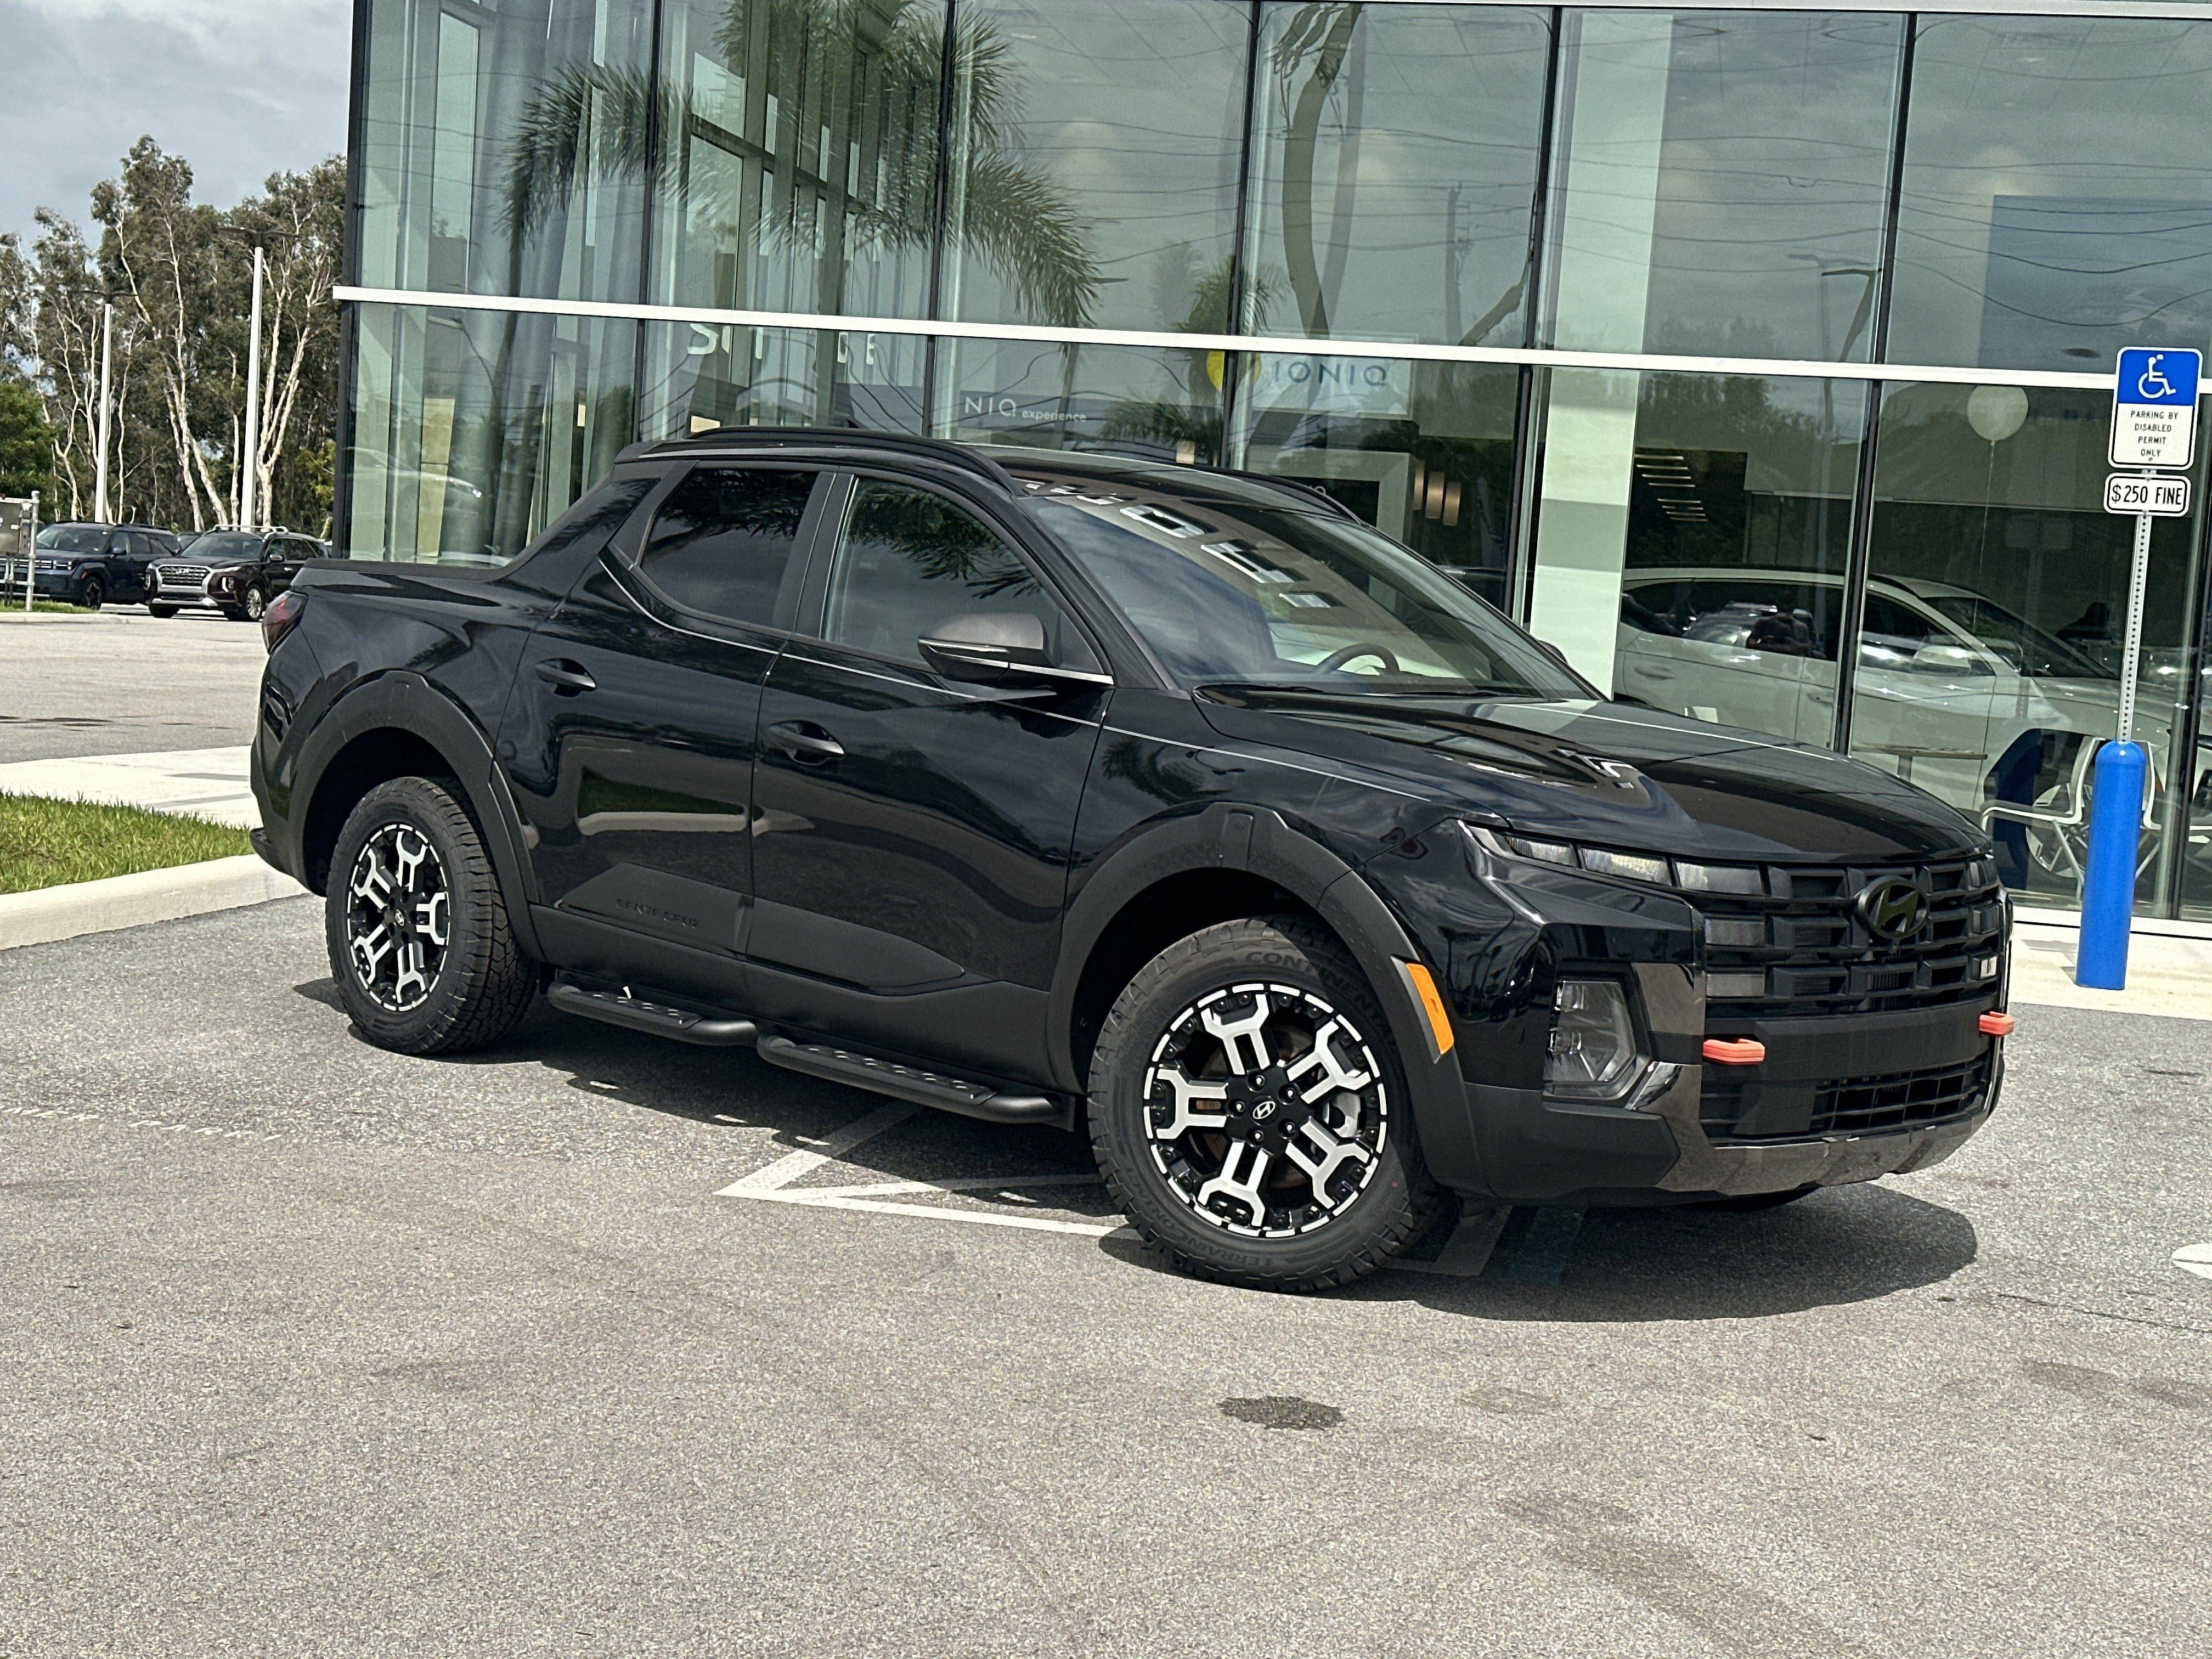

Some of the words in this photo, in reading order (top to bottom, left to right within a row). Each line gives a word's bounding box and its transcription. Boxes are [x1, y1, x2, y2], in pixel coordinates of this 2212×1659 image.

[1273, 360, 1387, 387] IONIQ
[1022, 408, 1086, 422] experience
[2130, 410, 2164, 420] PARKING
[2134, 423, 2172, 432] DISABLED
[2137, 436, 2166, 445] PERMIT
[2141, 448, 2161, 457] ONLY
[2112, 483, 2148, 504] $250
[2155, 487, 2183, 505] FINE
